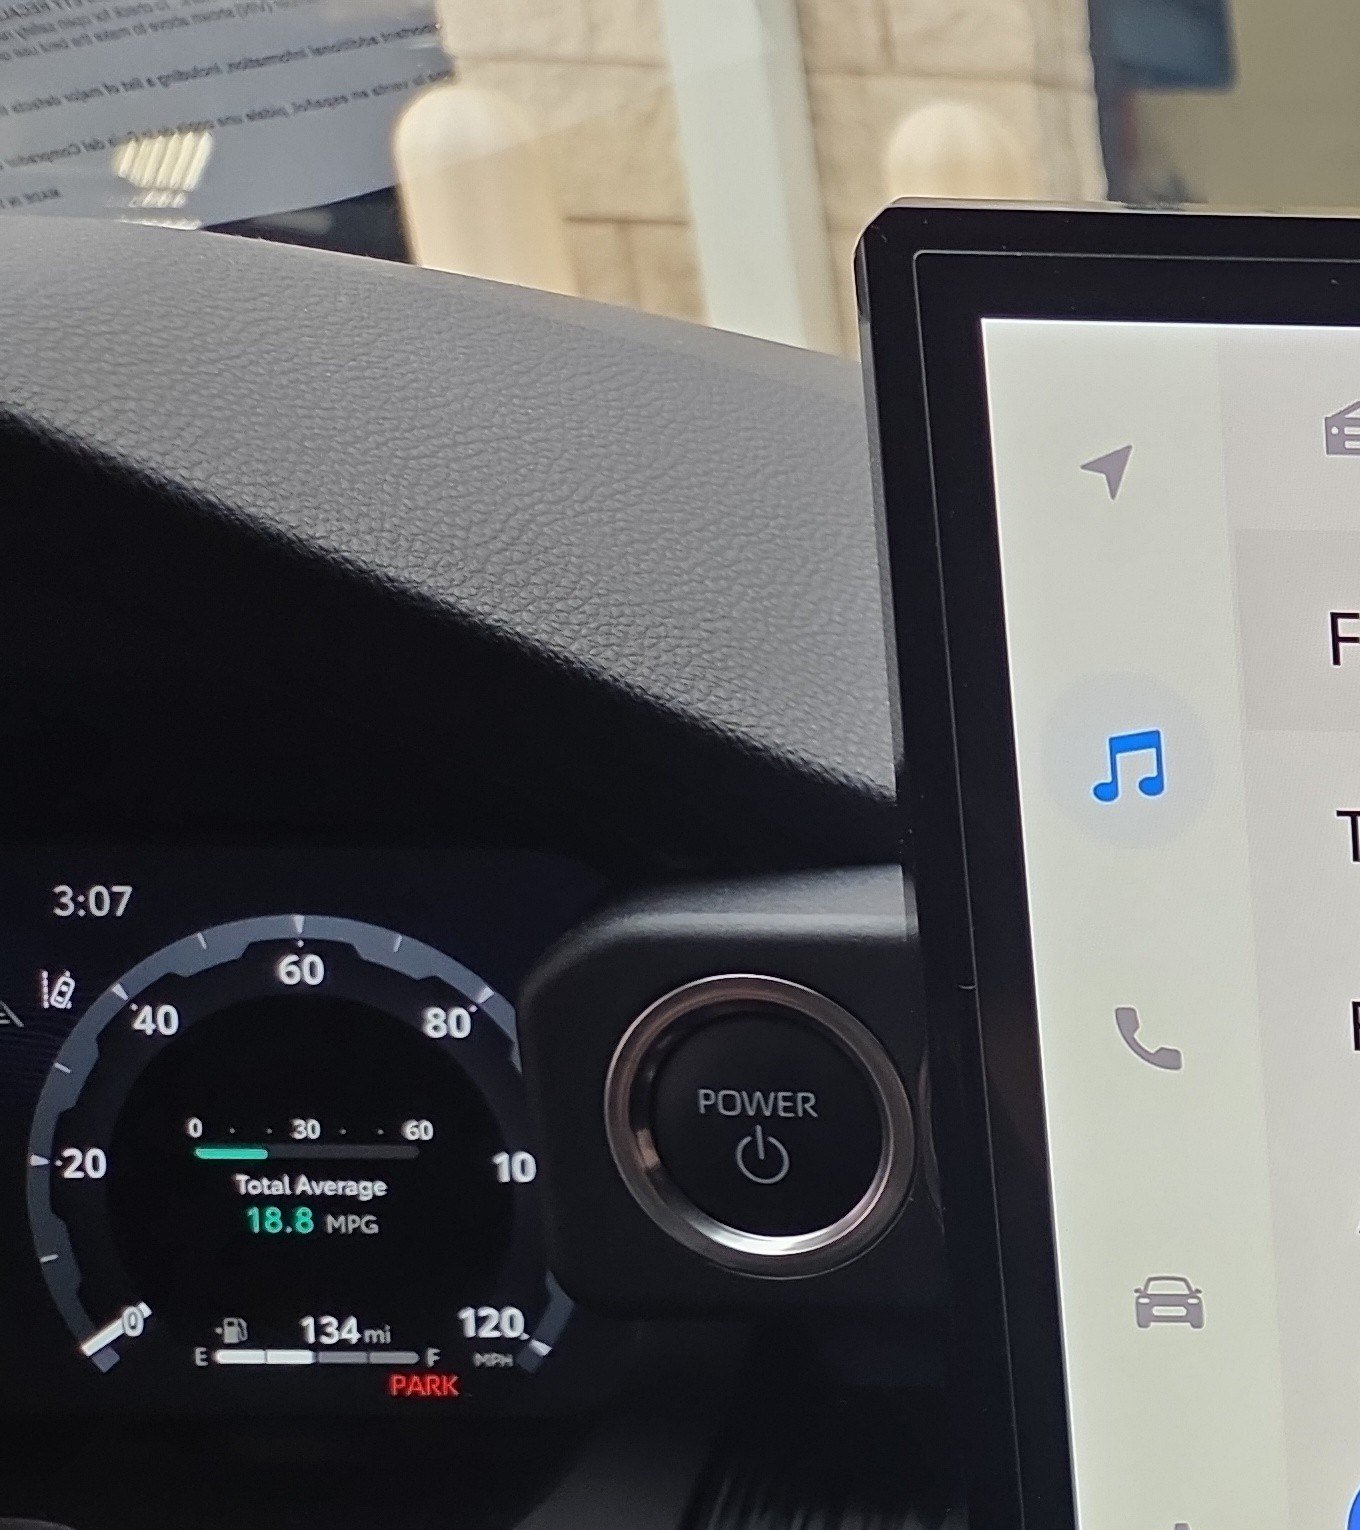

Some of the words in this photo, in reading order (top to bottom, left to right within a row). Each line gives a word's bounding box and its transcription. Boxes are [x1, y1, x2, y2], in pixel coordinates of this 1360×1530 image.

[54, 885, 132, 916] 3:07
[279, 955, 325, 986] 60
[133, 1006, 180, 1036] 40
[423, 1006, 472, 1039] 80
[699, 1089, 817, 1117] POWER
[187, 1118, 202, 1138] 0
[294, 1119, 320, 1139] 30
[403, 1120, 433, 1140] 60
[63, 1148, 108, 1179] 20
[236, 1174, 292, 1195] Total
[296, 1175, 387, 1201] Average
[248, 1207, 314, 1233] 18.8
[327, 1214, 378, 1234] MPG
[121, 1306, 145, 1337] 0
[302, 1316, 361, 1344] 134
[364, 1325, 391, 1343] mi
[458, 1306, 525, 1339] 120
[195, 1347, 208, 1366] E
[427, 1348, 440, 1366] F
[474, 1353, 513, 1366] MPH
[391, 1375, 458, 1396] PARK
